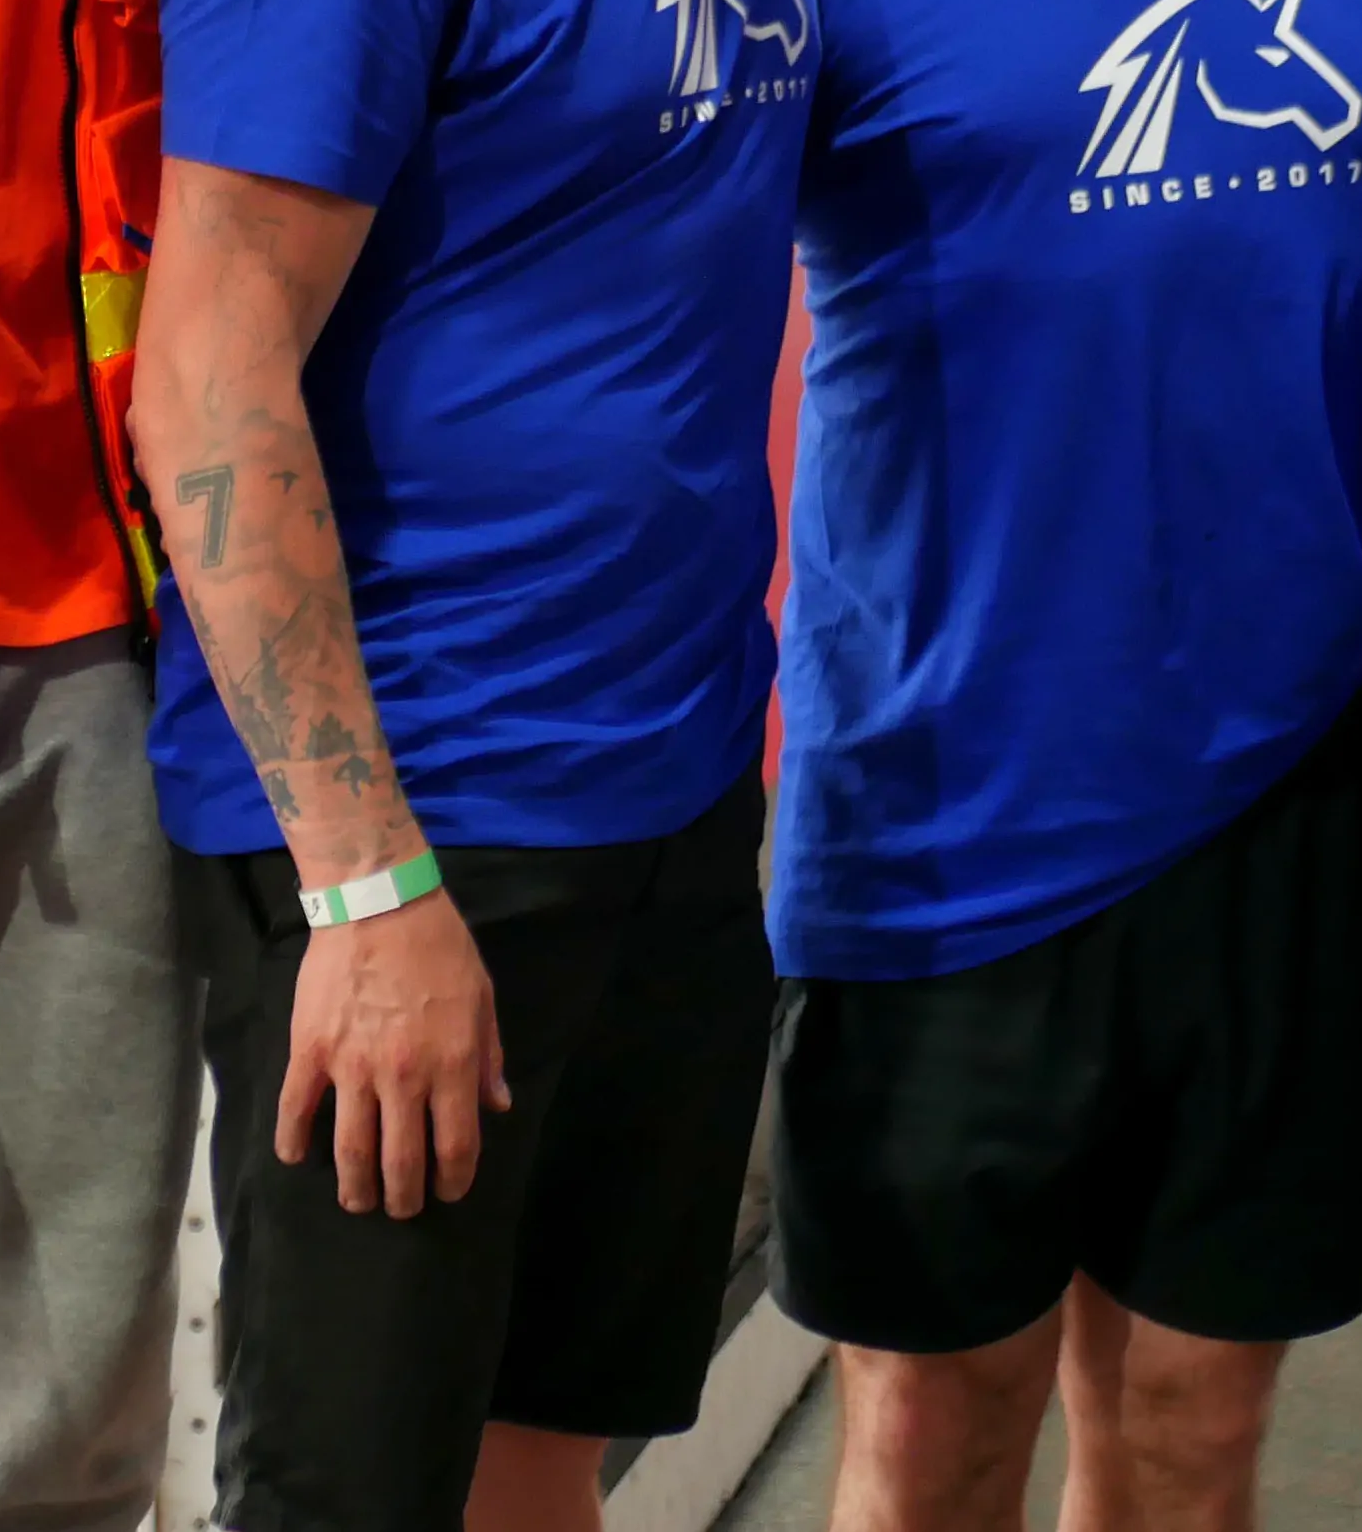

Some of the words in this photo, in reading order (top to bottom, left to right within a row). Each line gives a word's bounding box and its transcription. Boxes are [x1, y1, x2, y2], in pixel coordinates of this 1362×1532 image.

[1069, 174, 1213, 214] SINCE
[1257, 160, 1362, 192] 2017
[176, 464, 234, 570] 7
